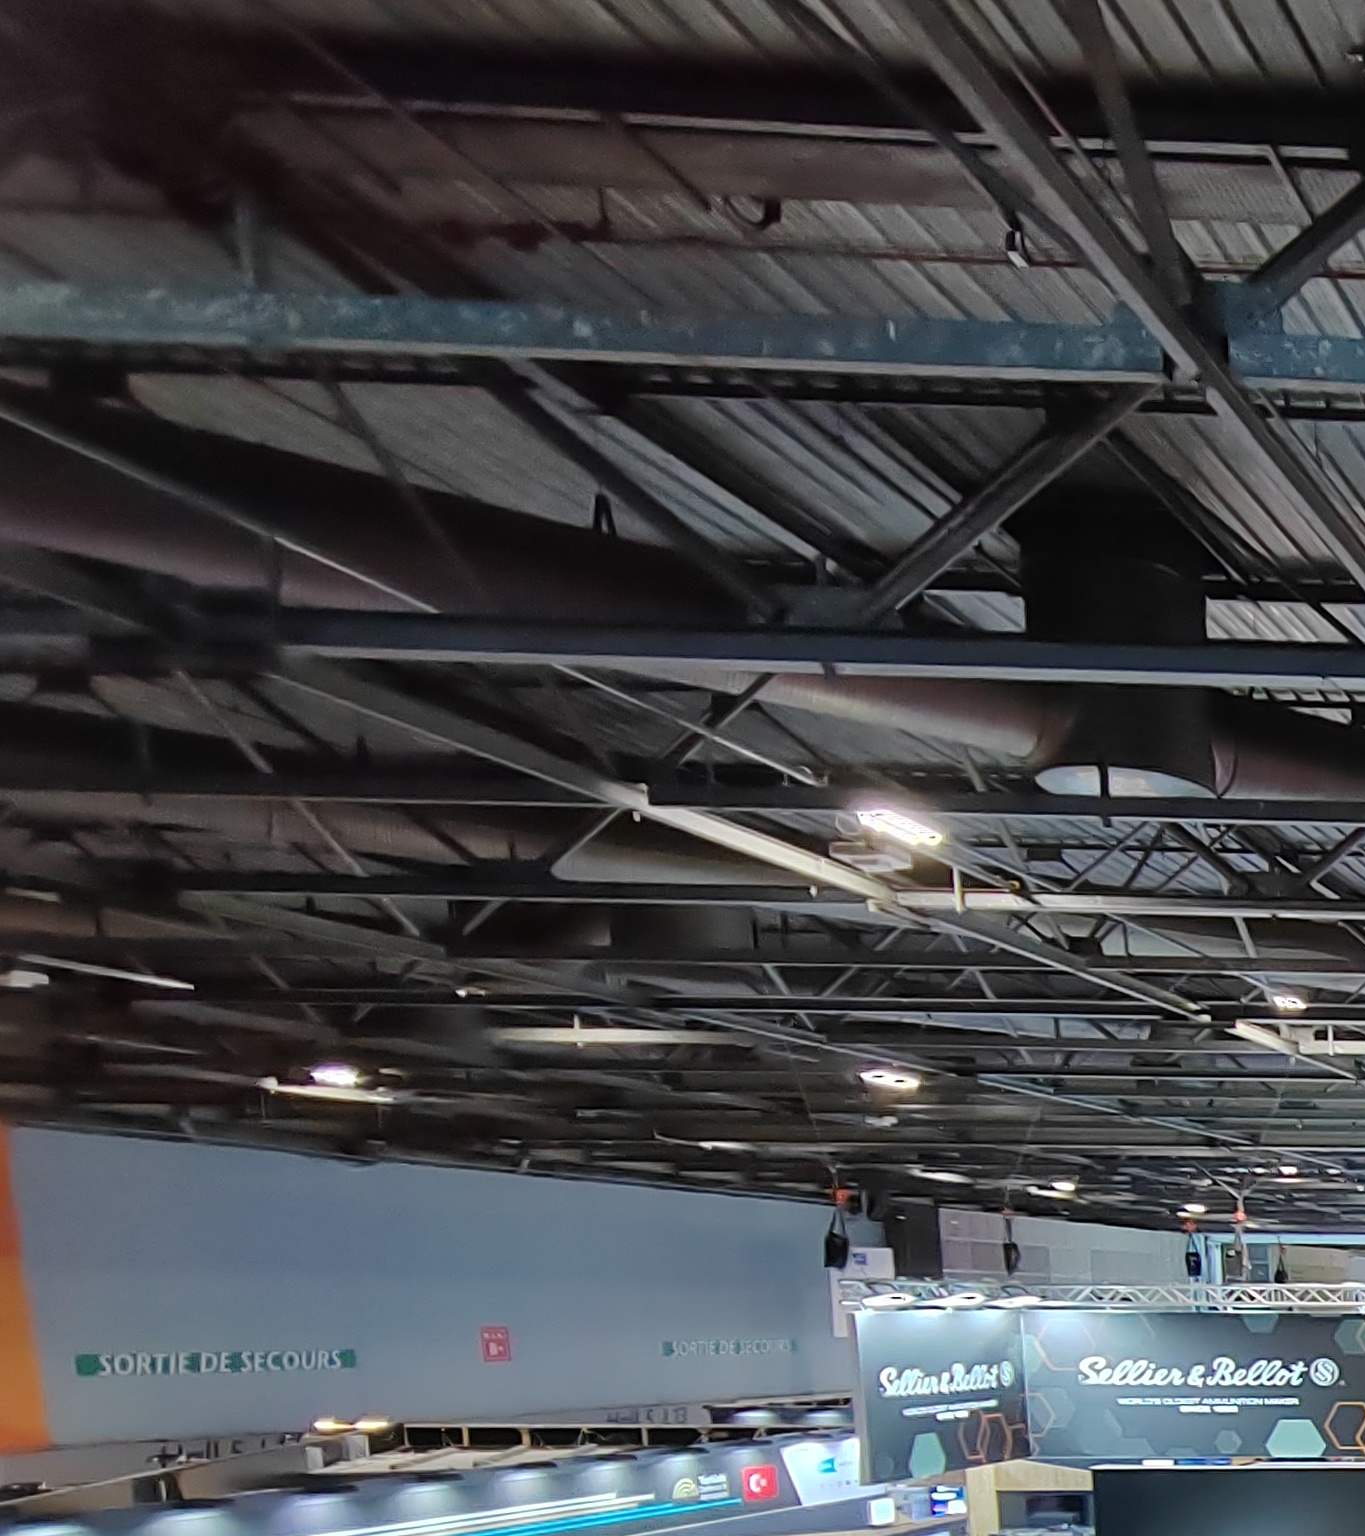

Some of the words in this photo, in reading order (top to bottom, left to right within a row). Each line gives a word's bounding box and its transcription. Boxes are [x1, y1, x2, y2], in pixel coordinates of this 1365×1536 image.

[98, 1352, 193, 1377] SORTIE
[200, 1351, 231, 1373] DE
[240, 1349, 342, 1373] SECOURS
[1078, 1356, 1185, 1386] Sellier
[1187, 1364, 1205, 1388] &
[1206, 1357, 1308, 1387] Bellot
[878, 1366, 939, 1397] Sellier
[950, 1362, 999, 1392] Bellot
